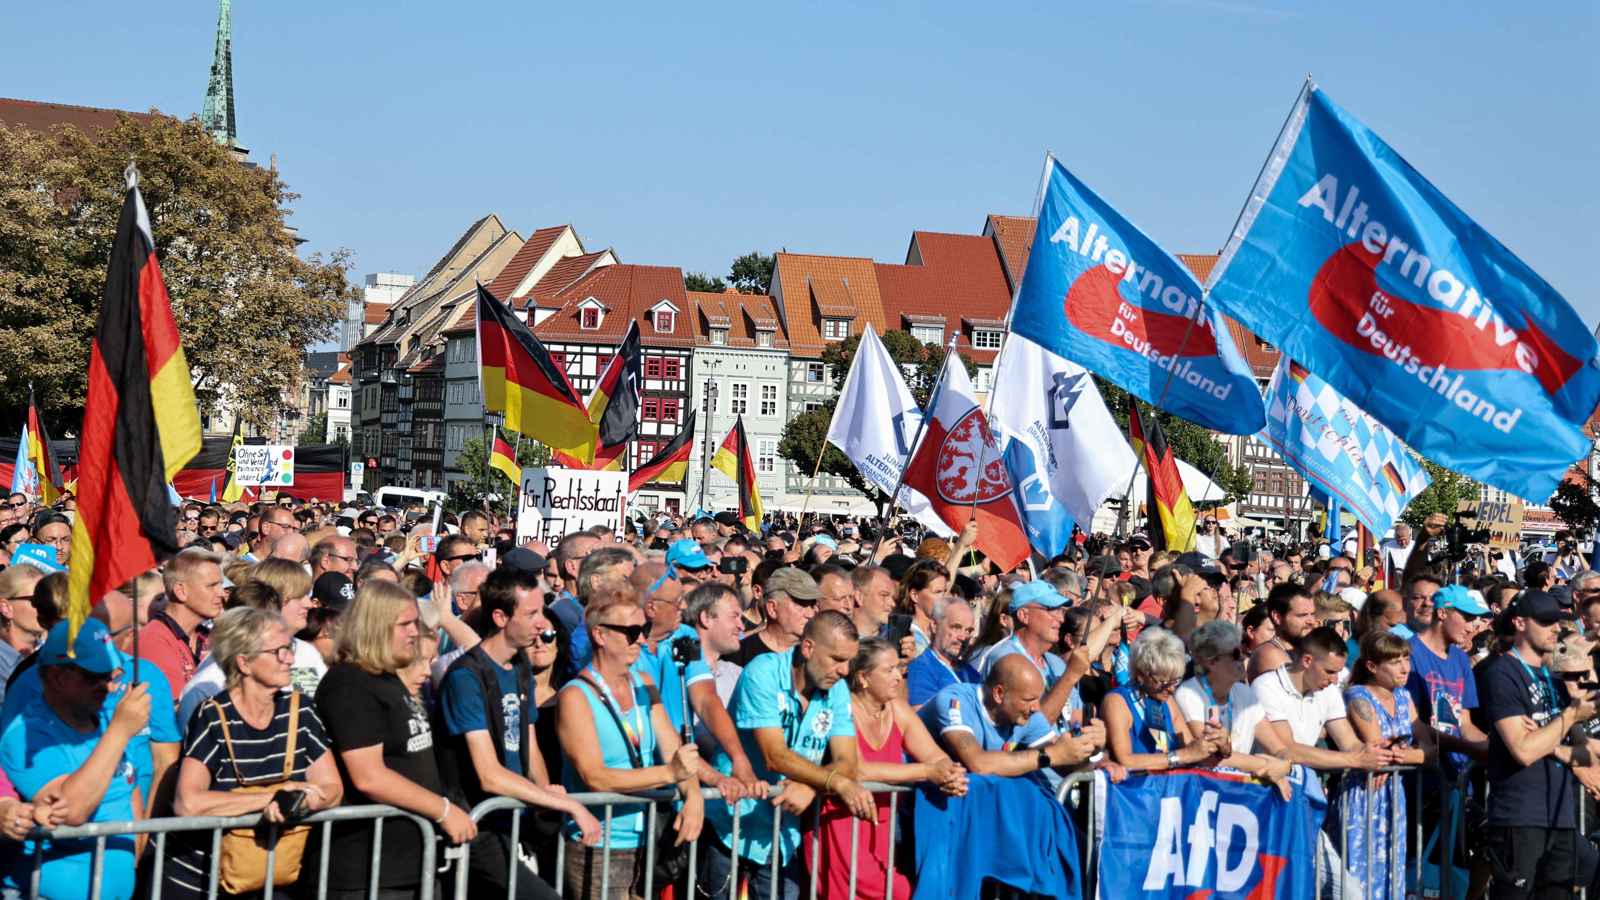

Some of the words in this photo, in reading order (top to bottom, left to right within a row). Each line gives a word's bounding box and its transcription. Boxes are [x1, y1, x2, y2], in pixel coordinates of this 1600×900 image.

[1298, 174, 1538, 373] Alternative
[1118, 302, 1137, 322] für
[1370, 291, 1395, 319] für
[1110, 318, 1232, 401] Deutschland
[1356, 313, 1522, 433] Deutschland
[238, 448, 256, 459] Ohne
[882, 452, 904, 472] JUNG
[522, 479, 541, 513] für
[1143, 790, 1259, 892] AfD
